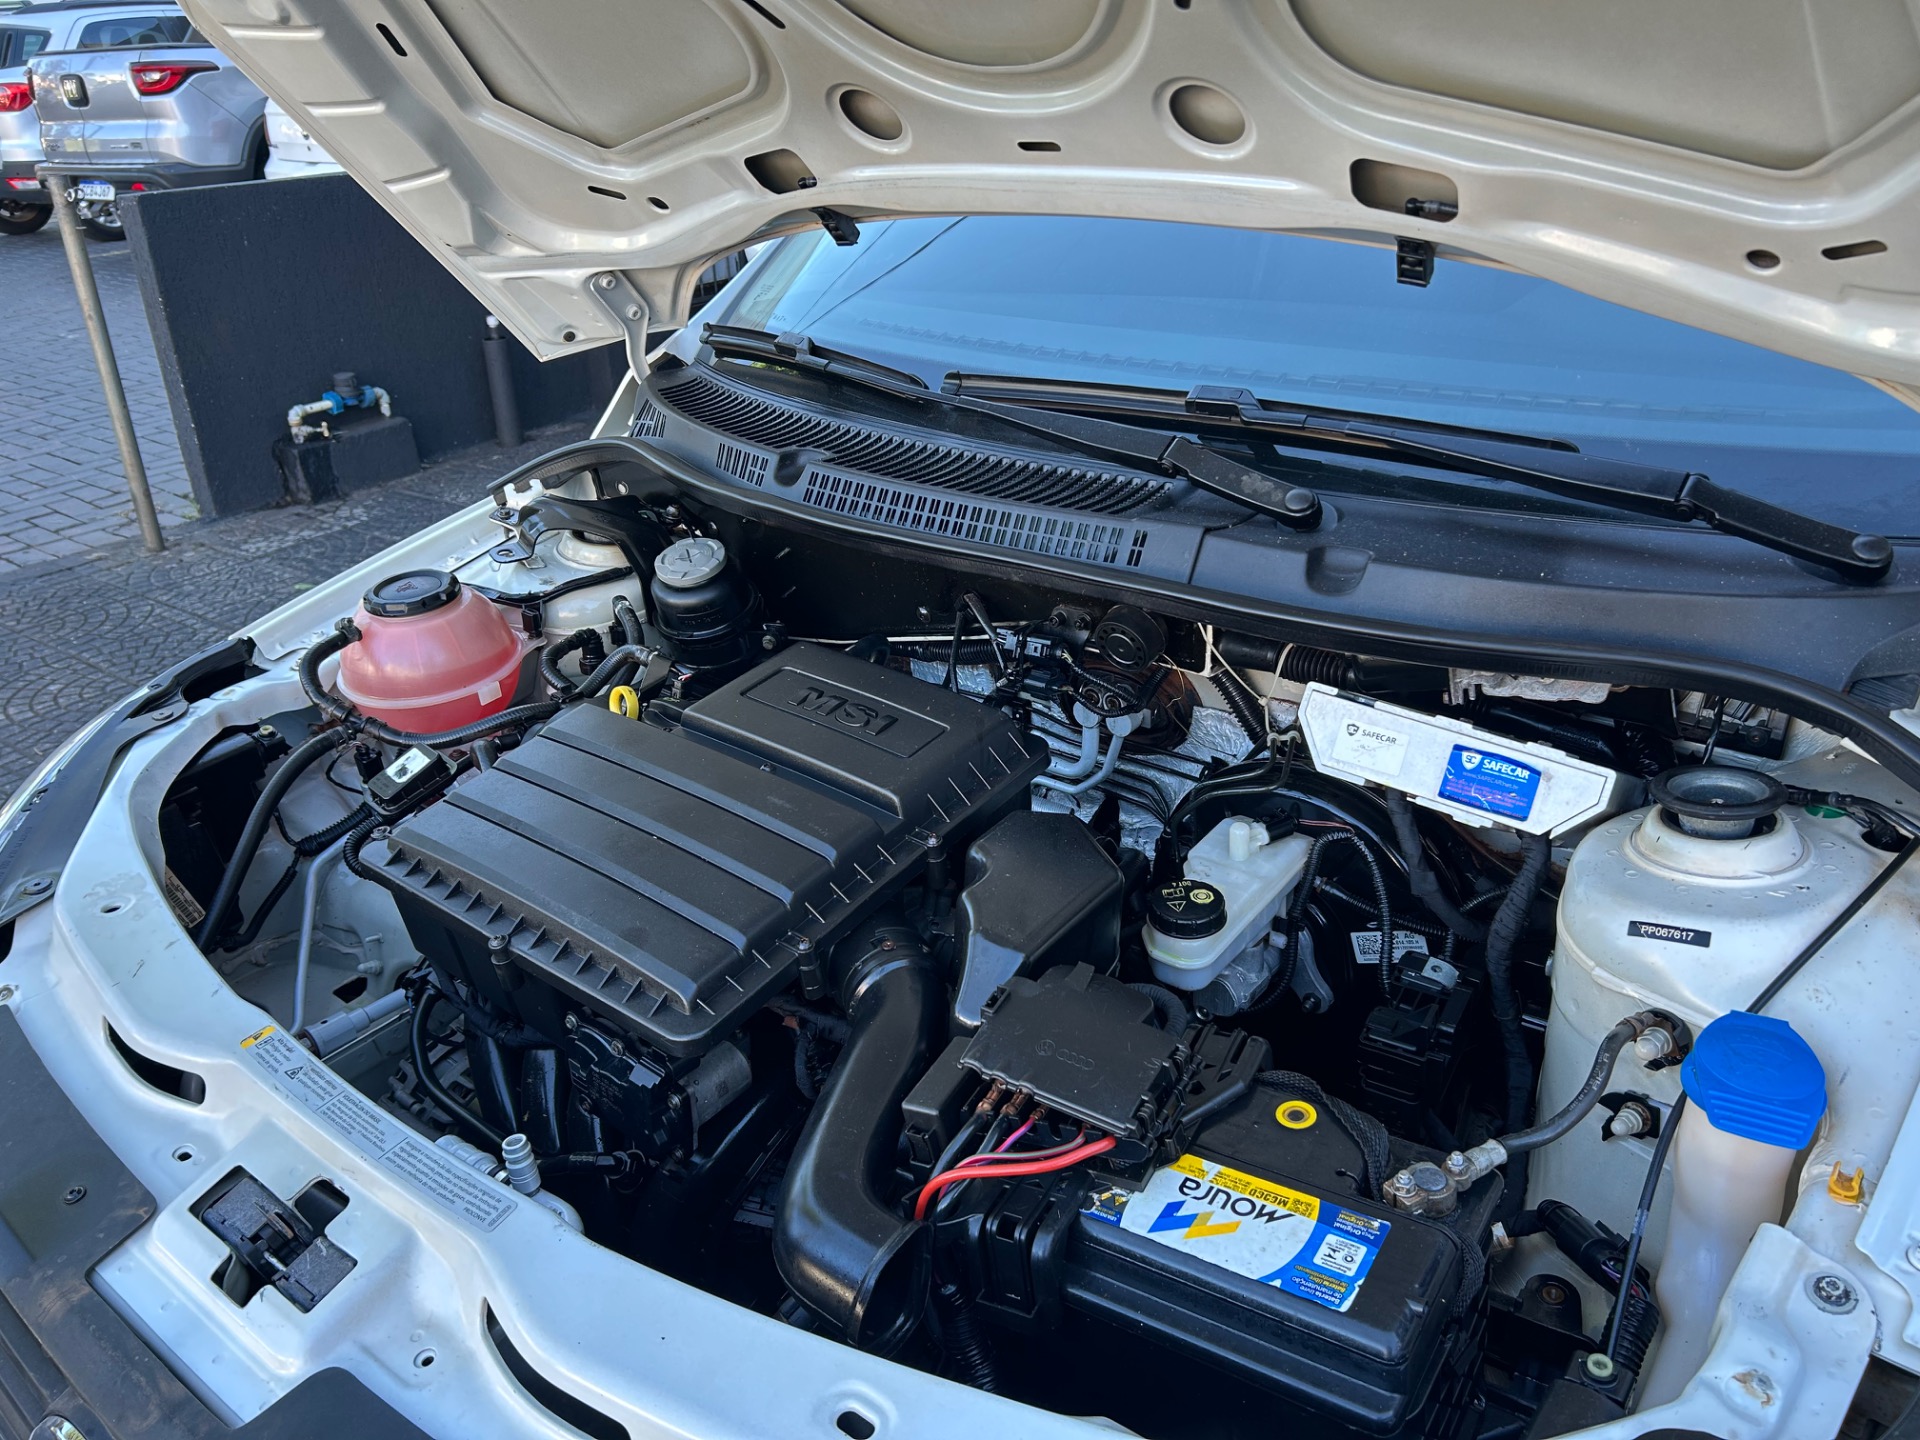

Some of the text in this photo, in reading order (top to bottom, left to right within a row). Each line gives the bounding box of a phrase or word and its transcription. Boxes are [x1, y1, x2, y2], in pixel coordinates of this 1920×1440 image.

[787, 685, 899, 737] MSI
[1361, 729, 1398, 745] SAFECAR
[1482, 759, 1531, 780] SAFECAR
[1640, 925, 1695, 941] PP067617
[390, 1151, 418, 1170] especialmente
[397, 1146, 419, 1161] regulagem
[404, 1141, 423, 1154] Assegure
[422, 1153, 448, 1170] manutenção
[450, 1172, 480, 1191] especificações
[477, 1188, 497, 1201] originais
[406, 1170, 424, 1183] melhoria
[1333, 1220, 1362, 1237] Original
[1291, 1275, 1333, 1296] manutenção
[1299, 1285, 1340, 1305] Bateria livre
